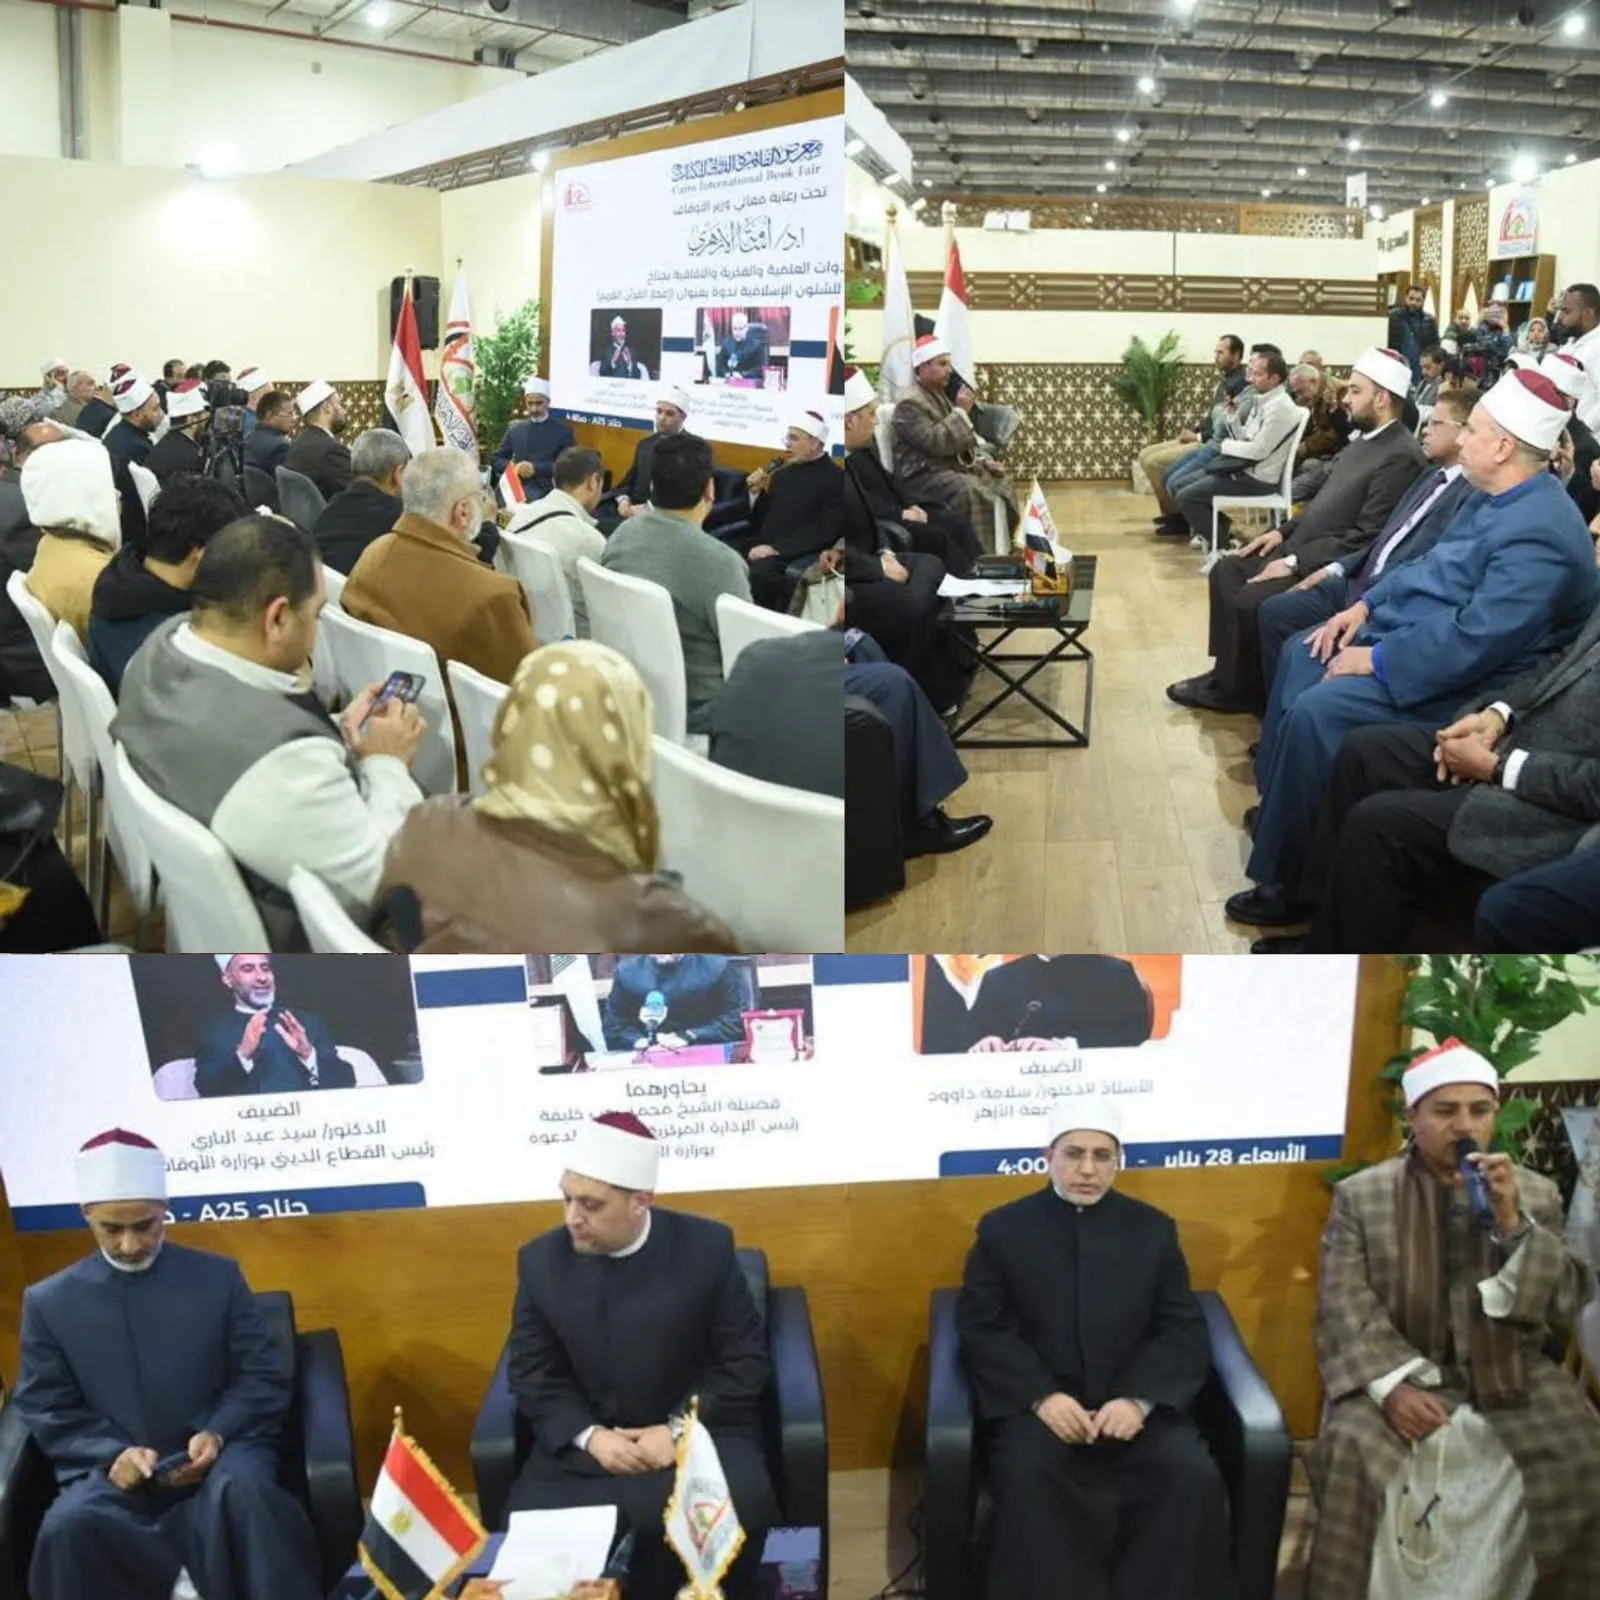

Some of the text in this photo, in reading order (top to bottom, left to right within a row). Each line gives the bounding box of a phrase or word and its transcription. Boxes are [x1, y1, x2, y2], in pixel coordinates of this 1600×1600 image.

[672, 164, 821, 194] Cairo International Book Fair
[800, 185, 828, 200] تحت
[733, 194, 767, 211] معالي
[719, 265, 764, 280] والفكرية
[766, 261, 810, 277] العلمية
[1019, 1057, 1082, 1075] الضيف
[626, 1080, 707, 1099] يحاورهما
[927, 1086, 977, 1104] داوود
[980, 1085, 1032, 1099] سلامة
[237, 1100, 301, 1119] الضيف
[677, 1099, 722, 1119] الشيخ
[726, 1097, 781, 1111] فضيلة
[280, 1126, 317, 1142] سيد
[321, 1119, 386, 1141] الدكتور/
[710, 1119, 755, 1136] الإدارة
[761, 1117, 799, 1134] رئيس
[243, 1127, 275, 1142] عبد
[327, 1144, 386, 1168] القطاع
[391, 1141, 435, 1160] رئيس
[674, 1143, 715, 1159] بوزارة
[1205, 1148, 1232, 1165] 28
[223, 1153, 266, 1170] بوزارة
[996, 1157, 1049, 1176] 4:00
[199, 1201, 250, 1221] A25
